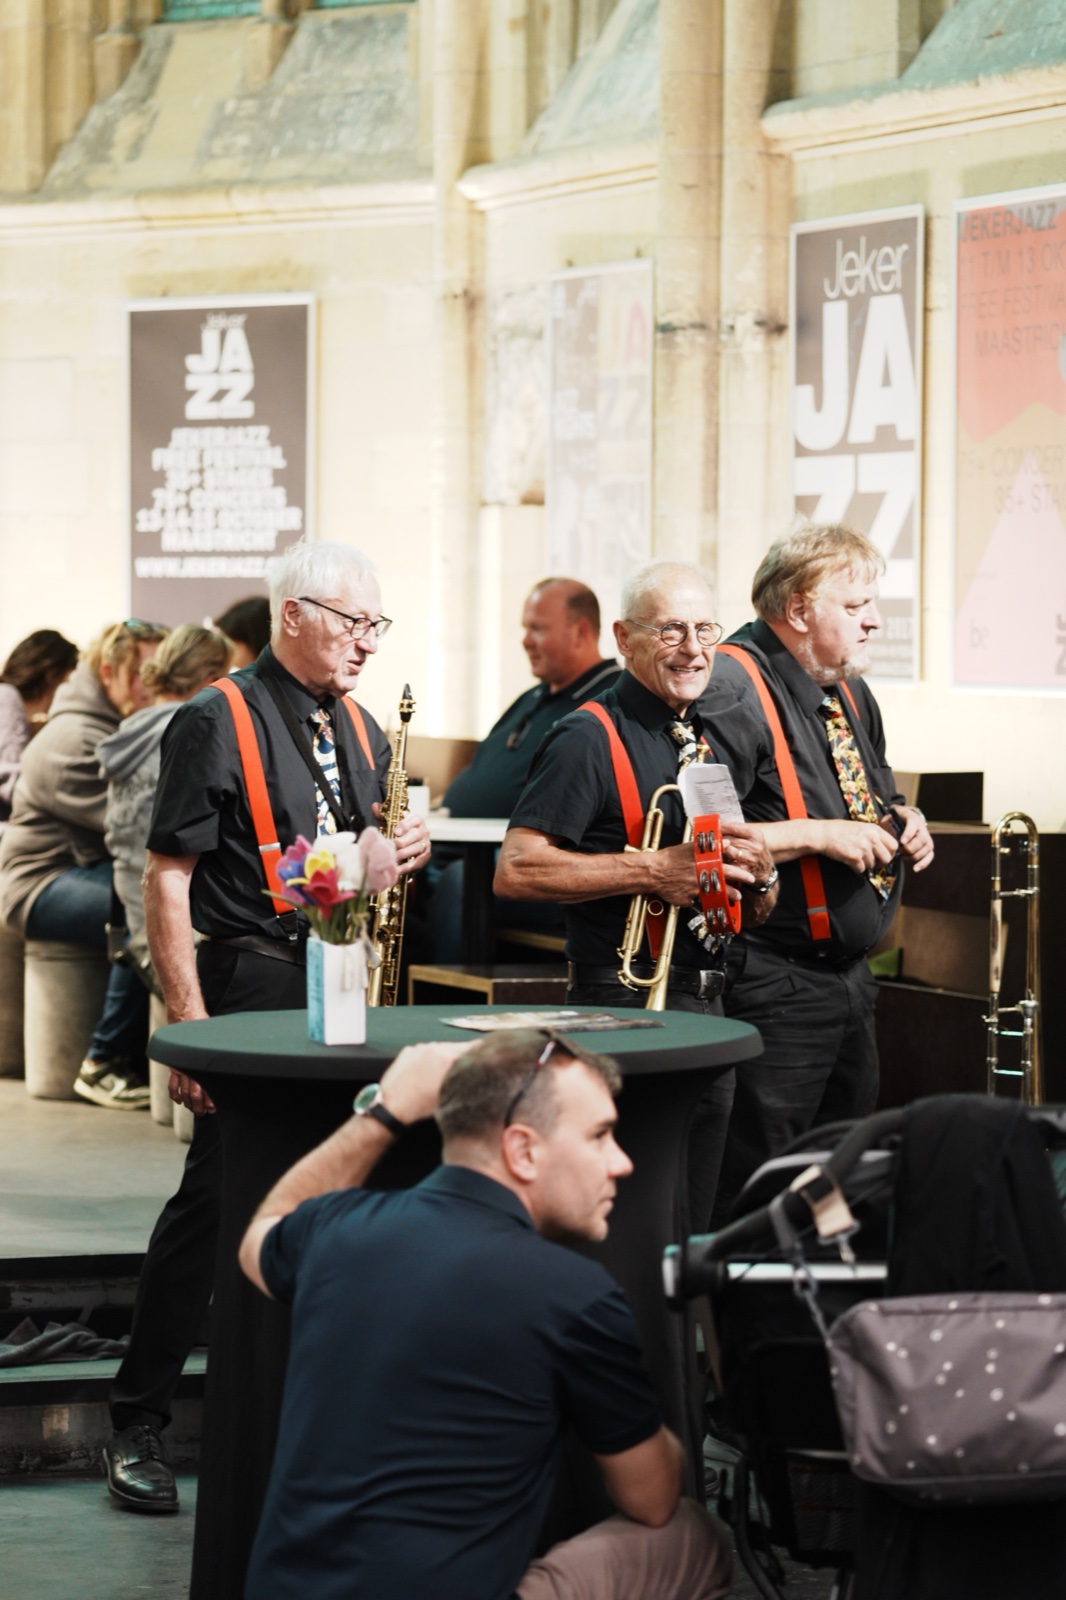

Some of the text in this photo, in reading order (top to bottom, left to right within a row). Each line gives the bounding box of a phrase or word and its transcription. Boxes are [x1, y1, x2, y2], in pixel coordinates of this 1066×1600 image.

[961, 202, 1056, 243] JEKERJAZZ
[823, 235, 910, 300] Jeker
[1018, 244, 1035, 275] 13
[185, 328, 254, 373] JA
[975, 322, 1066, 358] MAASTRIC
[794, 293, 916, 450] JA
[185, 372, 255, 420] ZZ
[990, 443, 1066, 478] CONCER
[1031, 482, 1066, 513] STA
